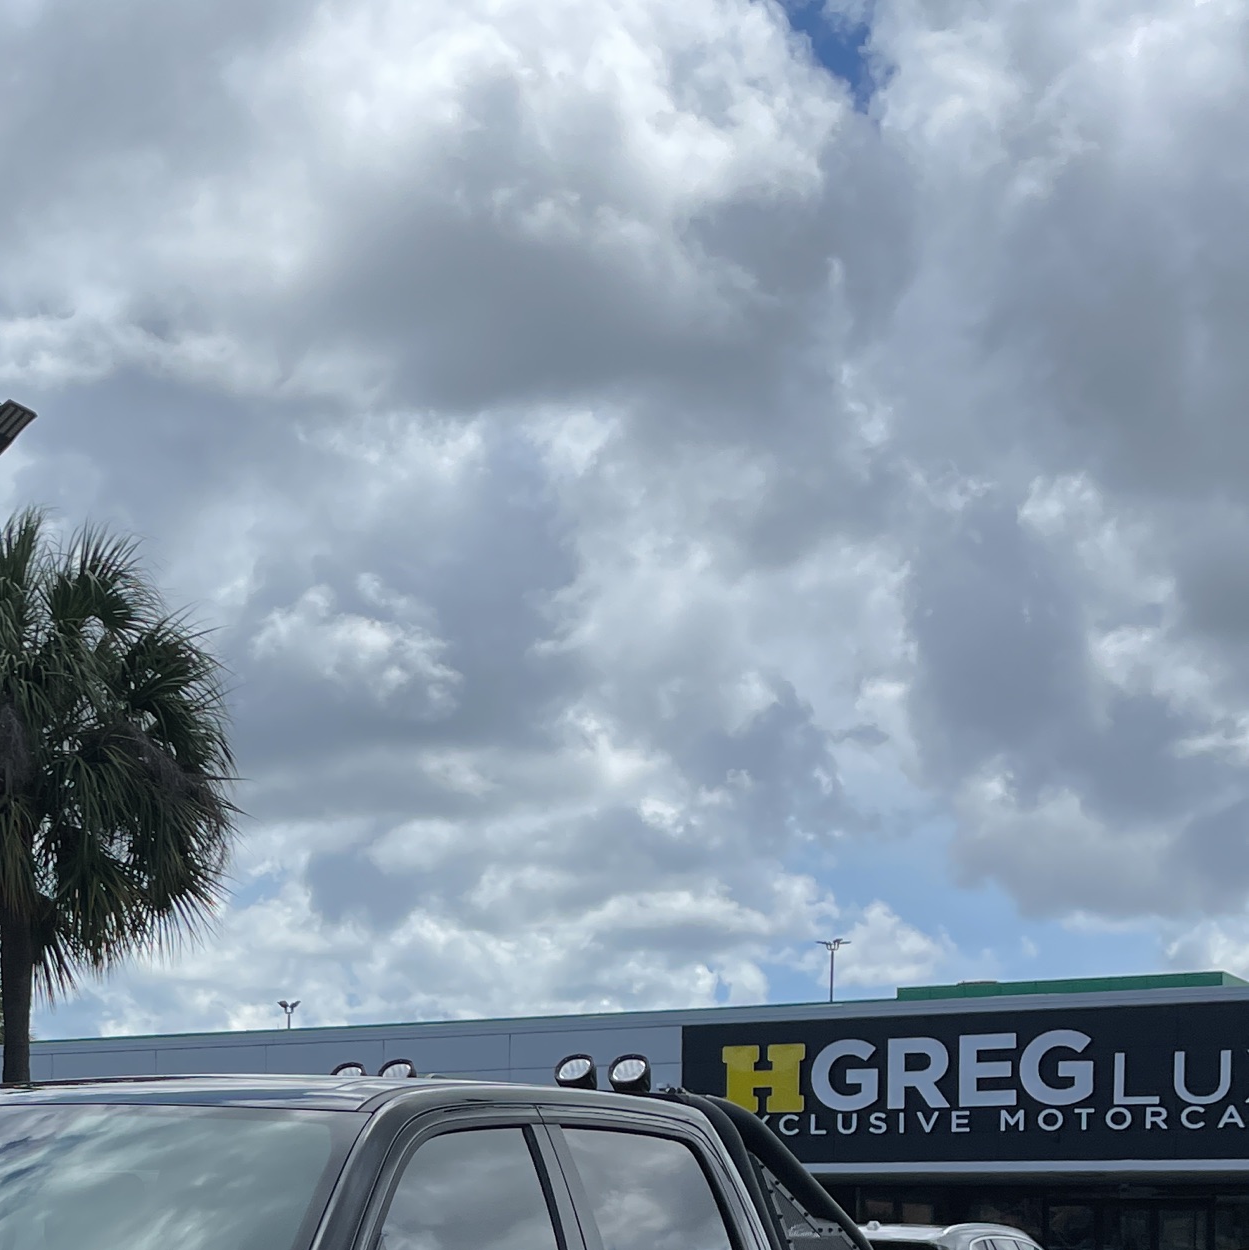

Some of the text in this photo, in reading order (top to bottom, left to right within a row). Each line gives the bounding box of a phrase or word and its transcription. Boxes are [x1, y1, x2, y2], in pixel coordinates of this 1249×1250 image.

[722, 1029, 1249, 1113] HGREG LU
[761, 1105, 1246, 1136] CLUSIVE MOTORCA
